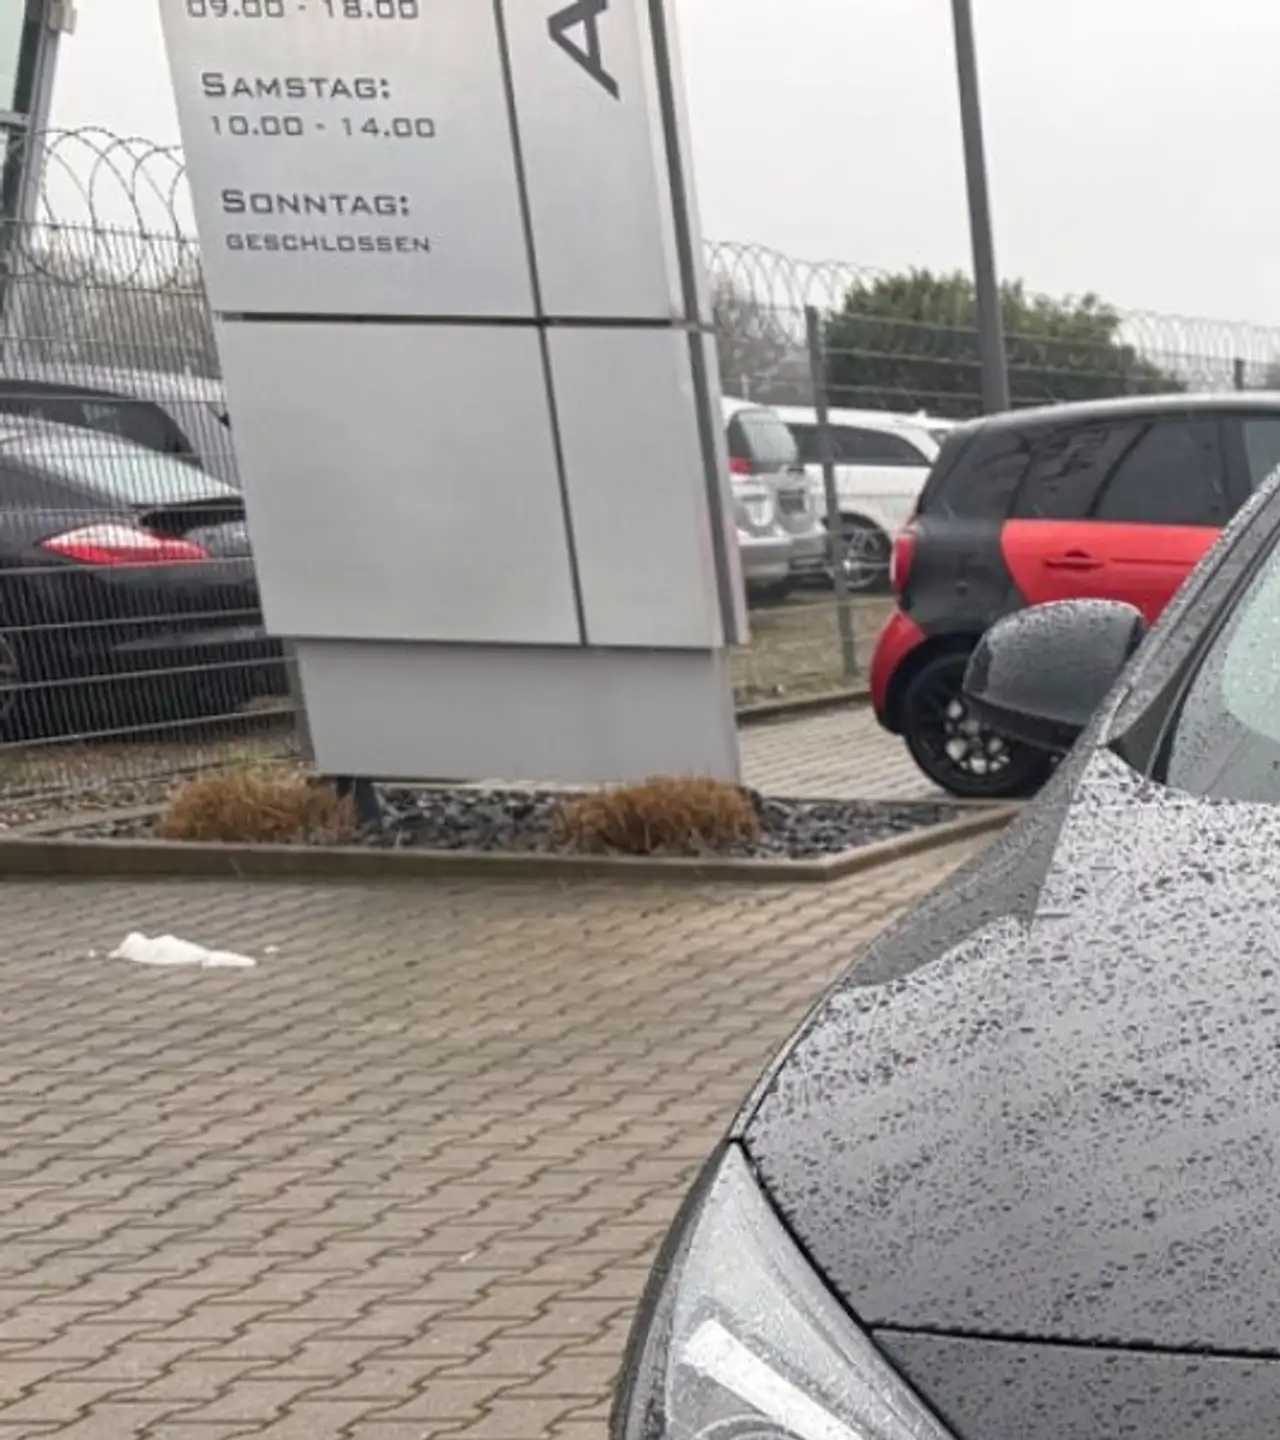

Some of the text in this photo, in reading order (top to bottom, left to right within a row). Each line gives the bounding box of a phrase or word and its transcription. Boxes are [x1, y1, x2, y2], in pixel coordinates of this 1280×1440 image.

[187, 0, 285, 18] 09.00
[325, 0, 420, 20] 18.00
[201, 72, 391, 99] SAMSTAG:
[211, 114, 304, 136] 10.00
[341, 116, 436, 138] 14.00
[221, 188, 410, 216] SONNTAG:
[225, 233, 431, 254] GESCHLOSSEN
